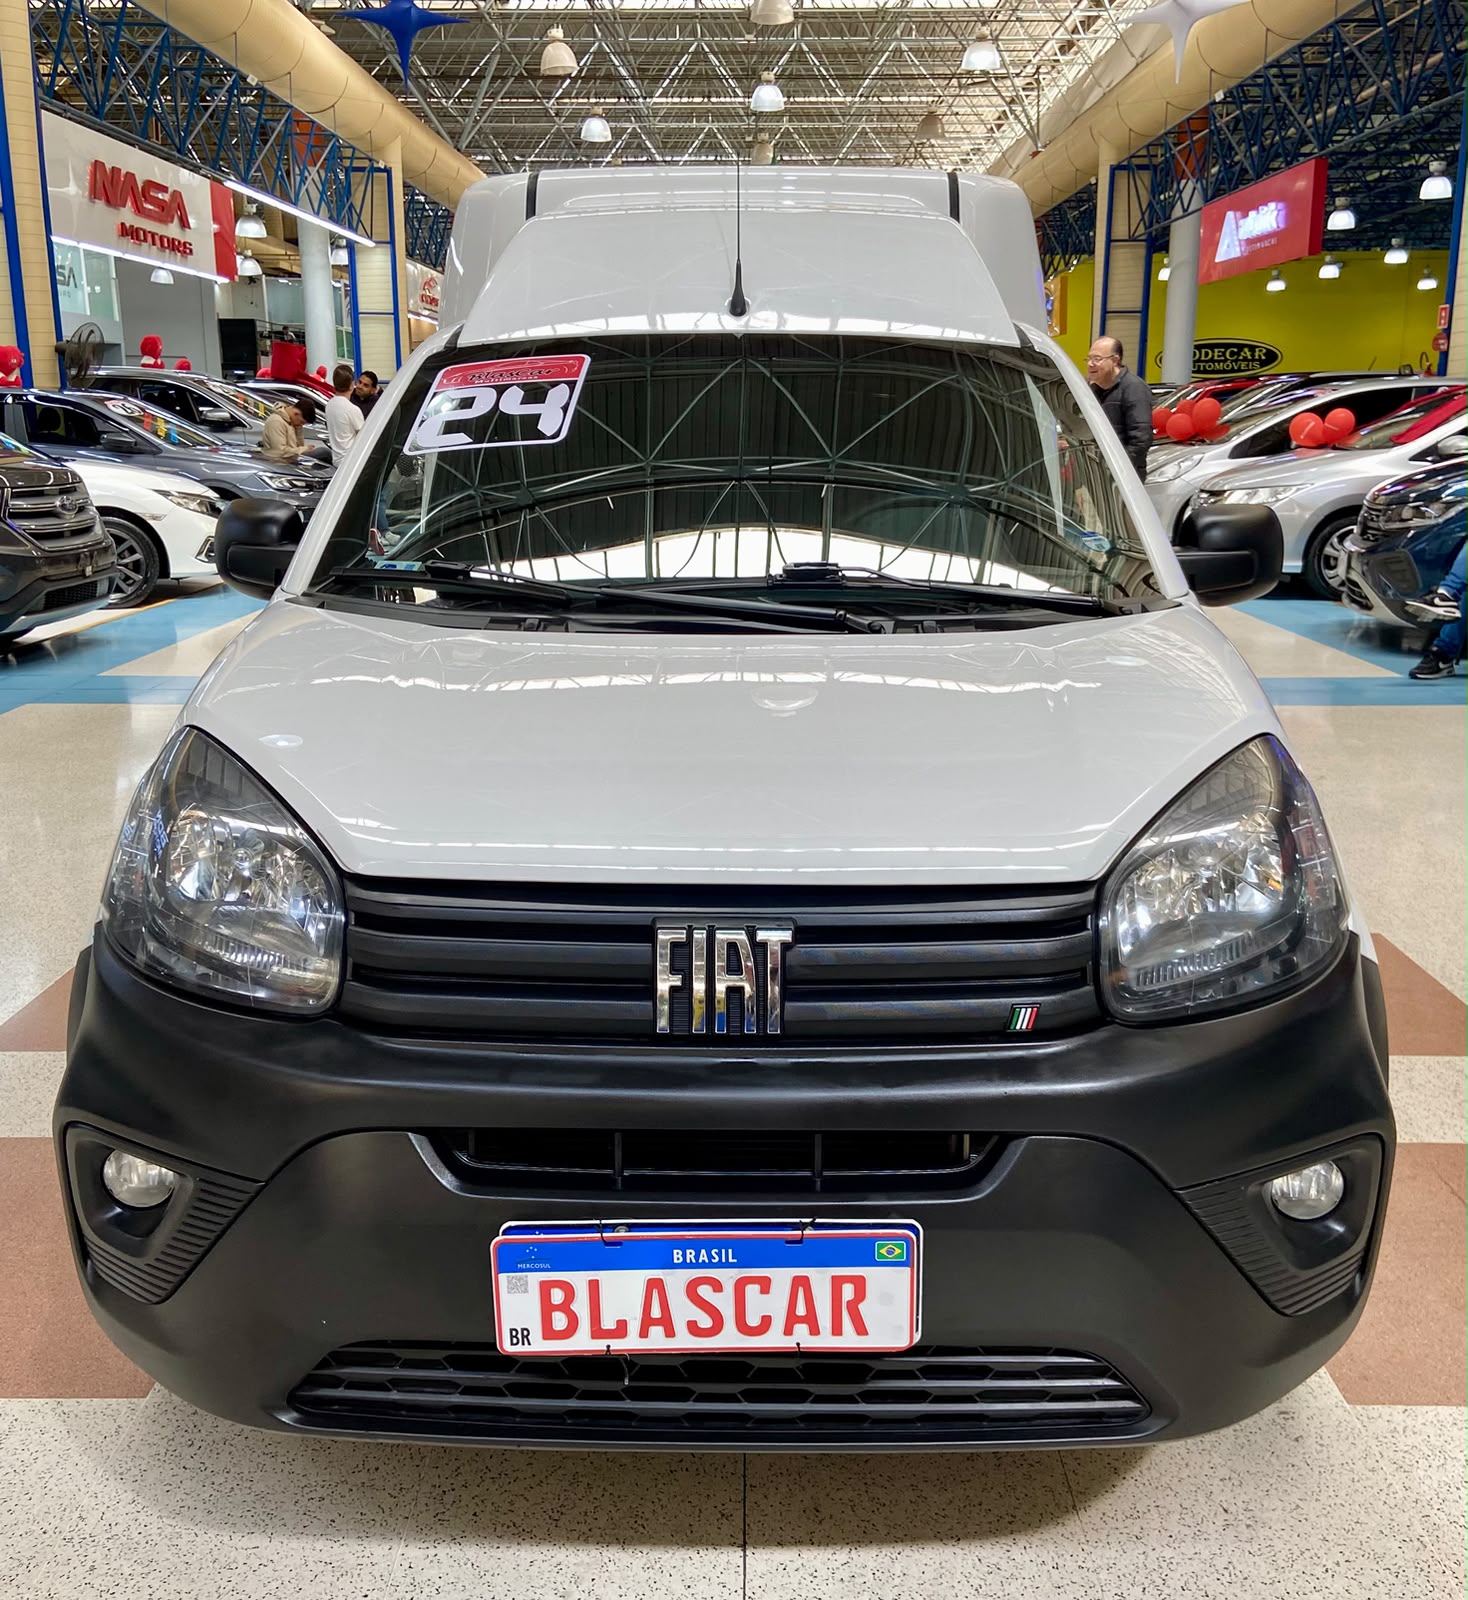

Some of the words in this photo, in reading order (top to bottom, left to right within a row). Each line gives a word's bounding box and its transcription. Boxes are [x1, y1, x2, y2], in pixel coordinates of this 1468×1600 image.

[90, 160, 191, 230] NASA
[117, 222, 193, 256] MOTORS
[1192, 361, 1260, 371] UTOMÓVEIS
[416, 383, 570, 448] 24
[656, 929, 792, 1034] FIAT
[672, 1248, 738, 1264] BRASIL
[538, 1274, 869, 1341] BLASCAR
[509, 1327, 531, 1346] BR
